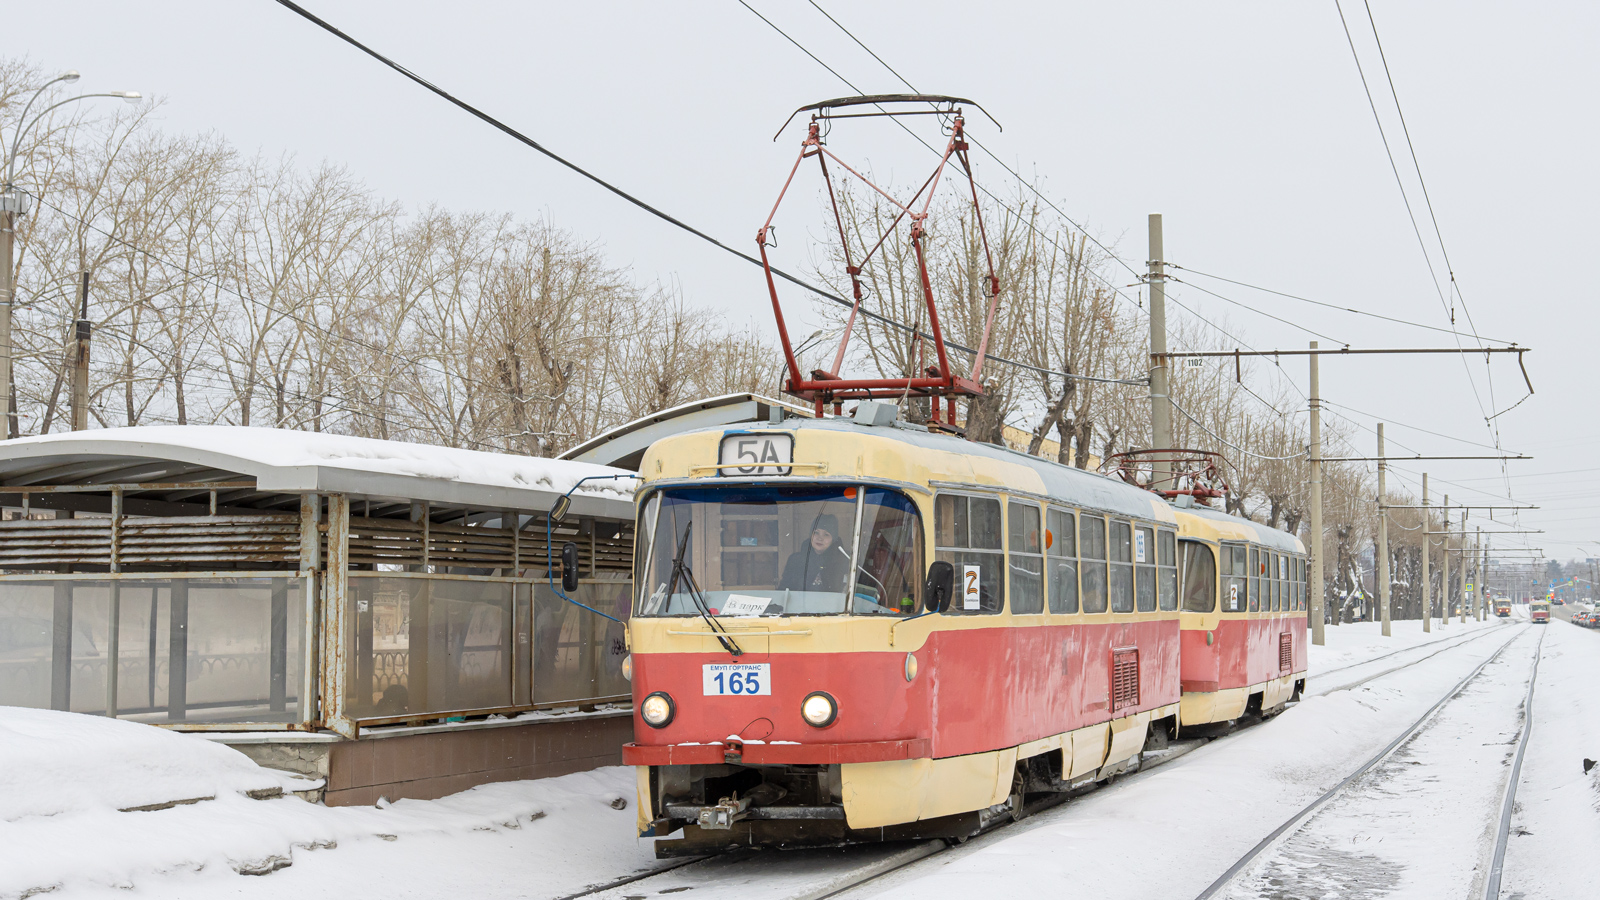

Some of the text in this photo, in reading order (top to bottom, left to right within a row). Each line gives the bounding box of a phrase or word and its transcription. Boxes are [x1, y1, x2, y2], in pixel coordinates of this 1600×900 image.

[1187, 358, 1203, 367] 1102
[737, 439, 784, 474] 5А
[728, 600, 765, 612] В парк
[713, 672, 760, 695] 165
